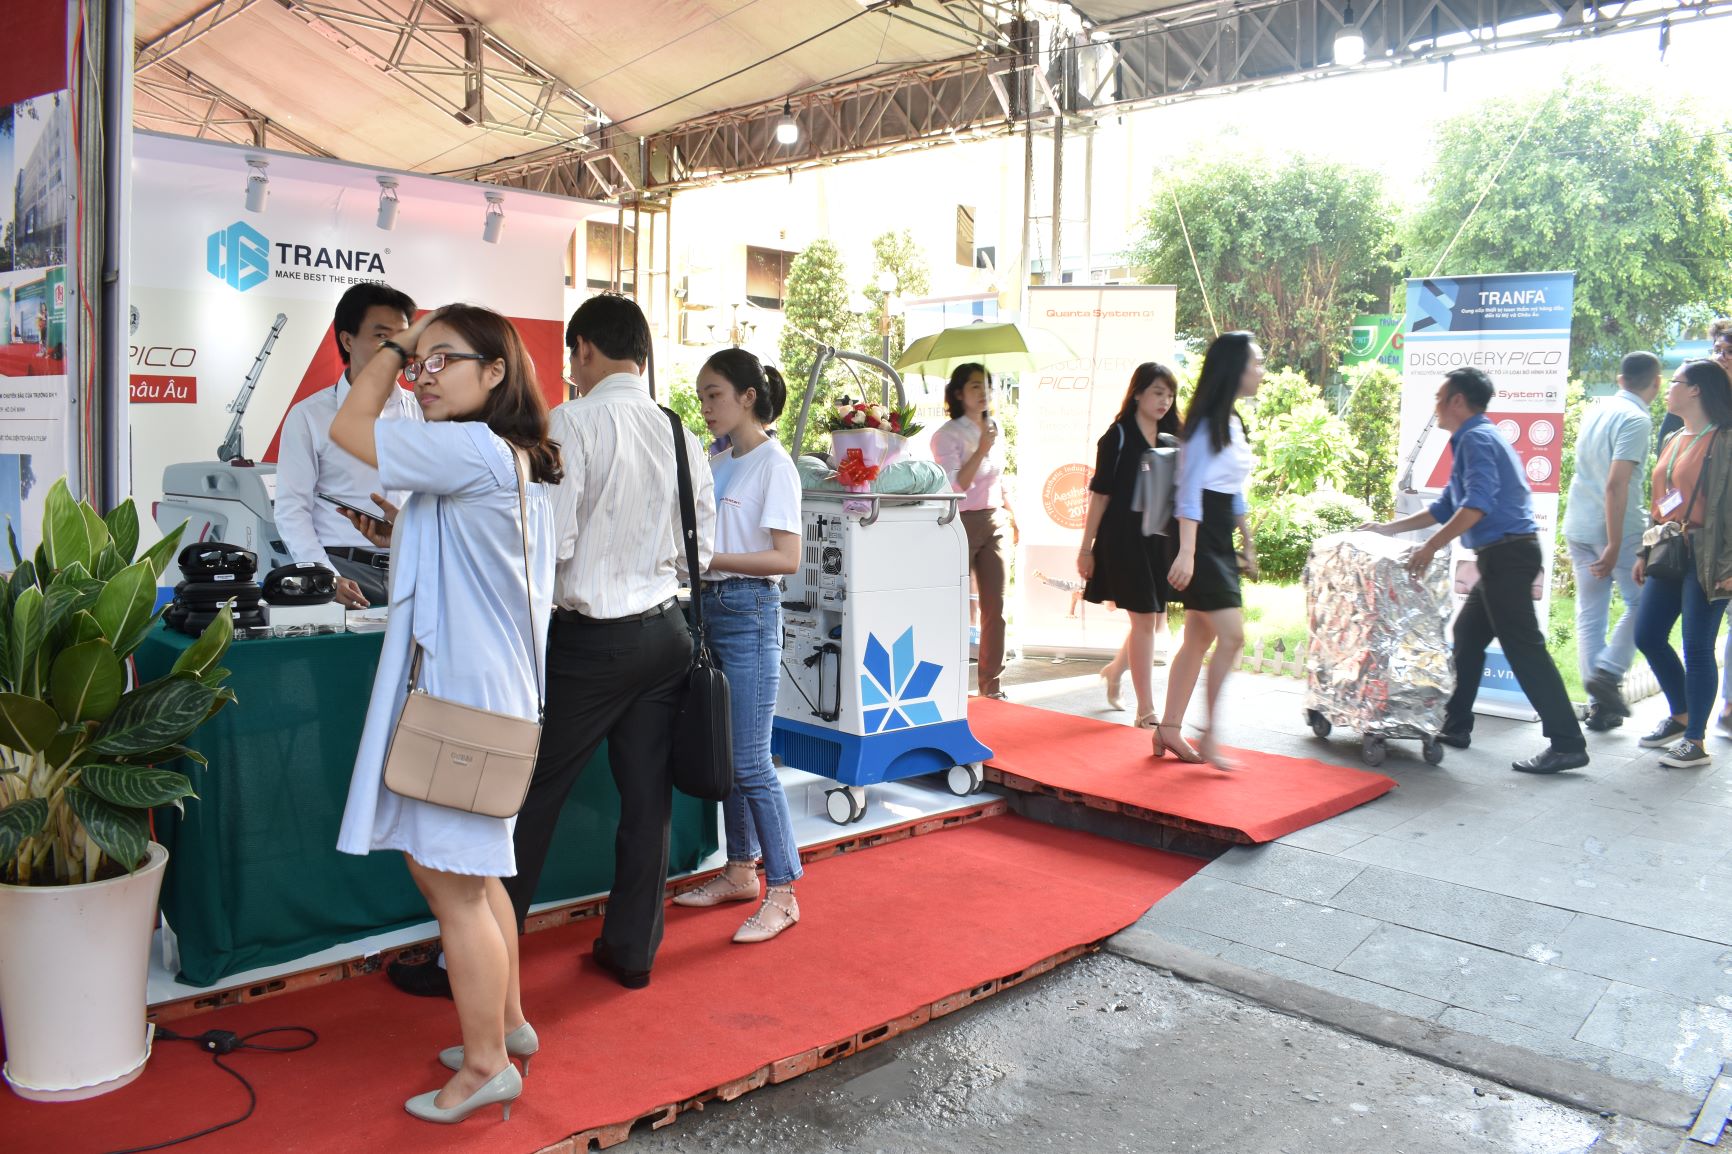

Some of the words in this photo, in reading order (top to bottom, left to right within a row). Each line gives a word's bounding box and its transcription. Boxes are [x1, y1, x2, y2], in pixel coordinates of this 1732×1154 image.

[275, 242, 386, 274] TRANFA
[275, 269, 302, 280] MAKE
[303, 272, 327, 282] BEST
[329, 274, 346, 284] THE
[1479, 290, 1546, 305] TRANFA
[1046, 309, 1091, 318] Quanta
[1092, 309, 1141, 319] System
[163, 379, 188, 399] Âu
[1038, 376, 1090, 389] PICO
[1498, 390, 1544, 400] System
